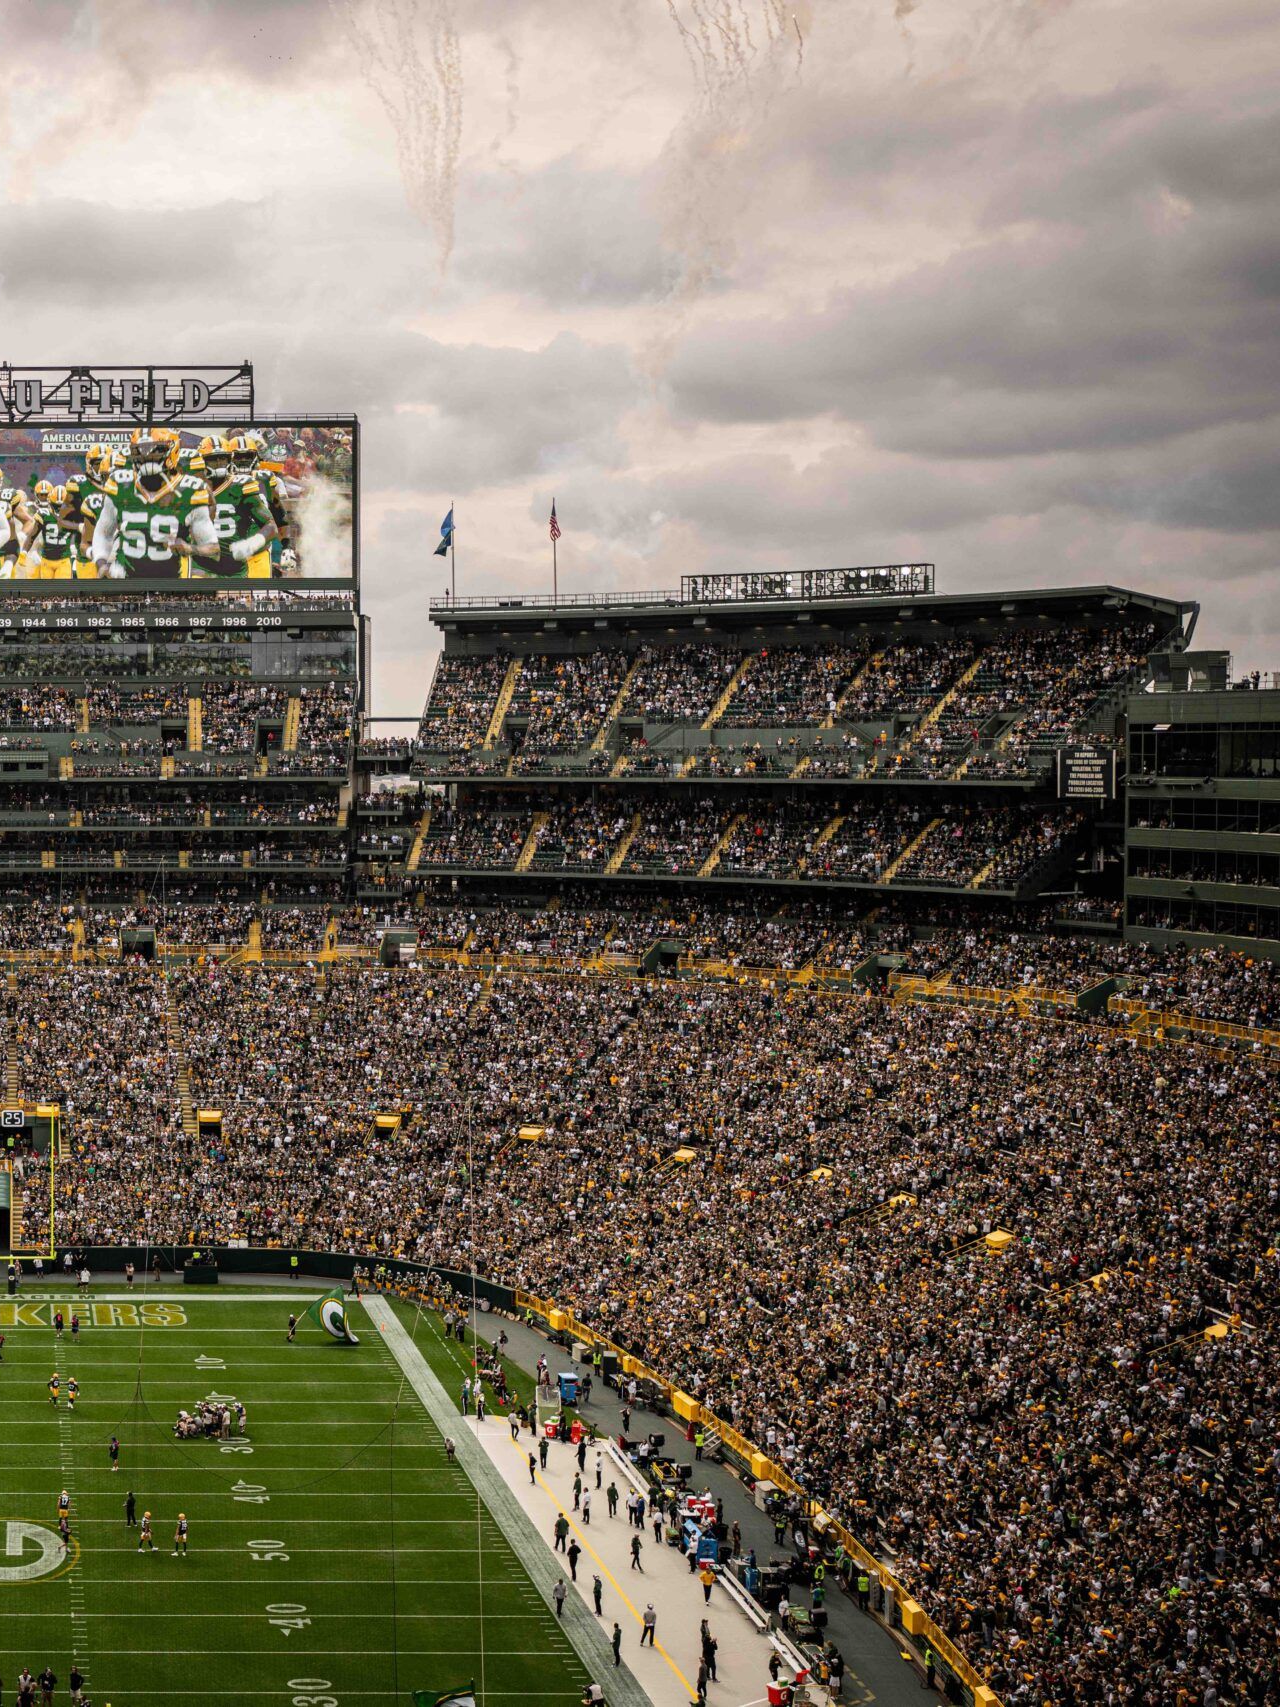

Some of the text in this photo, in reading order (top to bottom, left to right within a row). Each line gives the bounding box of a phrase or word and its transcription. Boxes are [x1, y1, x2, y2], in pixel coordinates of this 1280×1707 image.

[69, 379, 210, 413] FIELD
[42, 433, 95, 442] AMERICAN
[120, 510, 179, 561] 59
[21, 618, 47, 627] 1944
[56, 618, 79, 627] 1961
[87, 618, 112, 627] 1962
[120, 618, 145, 627] 1965
[154, 618, 180, 627] 1966
[188, 617, 213, 627] 1967
[222, 617, 247, 627] 1996
[256, 617, 282, 626] 2010
[6, 1113, 20, 1124] 25
[246, 1540, 290, 1562] 50
